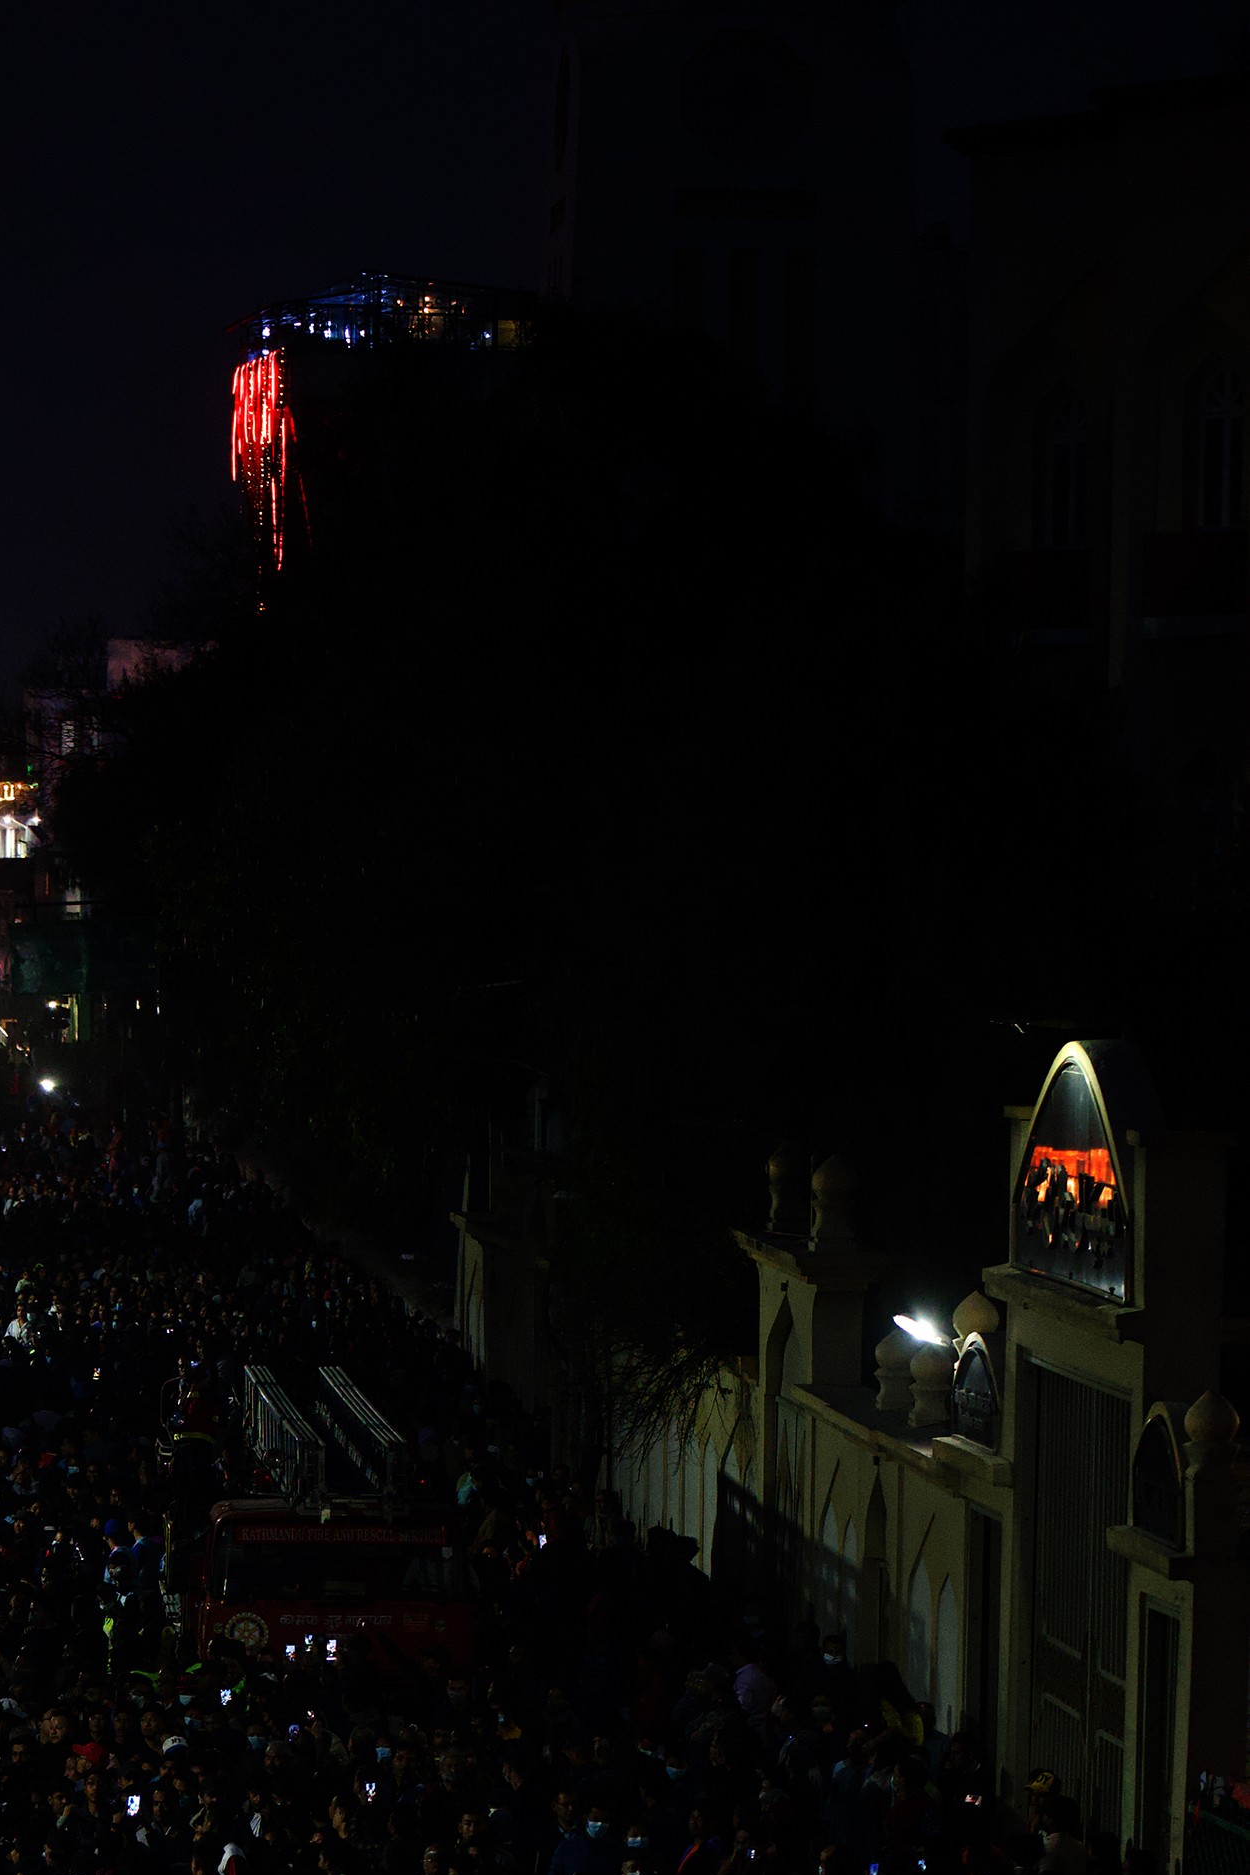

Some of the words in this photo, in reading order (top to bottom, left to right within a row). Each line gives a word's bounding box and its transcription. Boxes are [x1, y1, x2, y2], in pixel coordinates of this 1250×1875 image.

[241, 1527, 305, 1541] KATHMANDU
[307, 1528, 331, 1541] FIRE
[333, 1528, 354, 1542] AND
[356, 1528, 396, 1542] RESCUE
[398, 1530, 441, 1543] SERVICE
